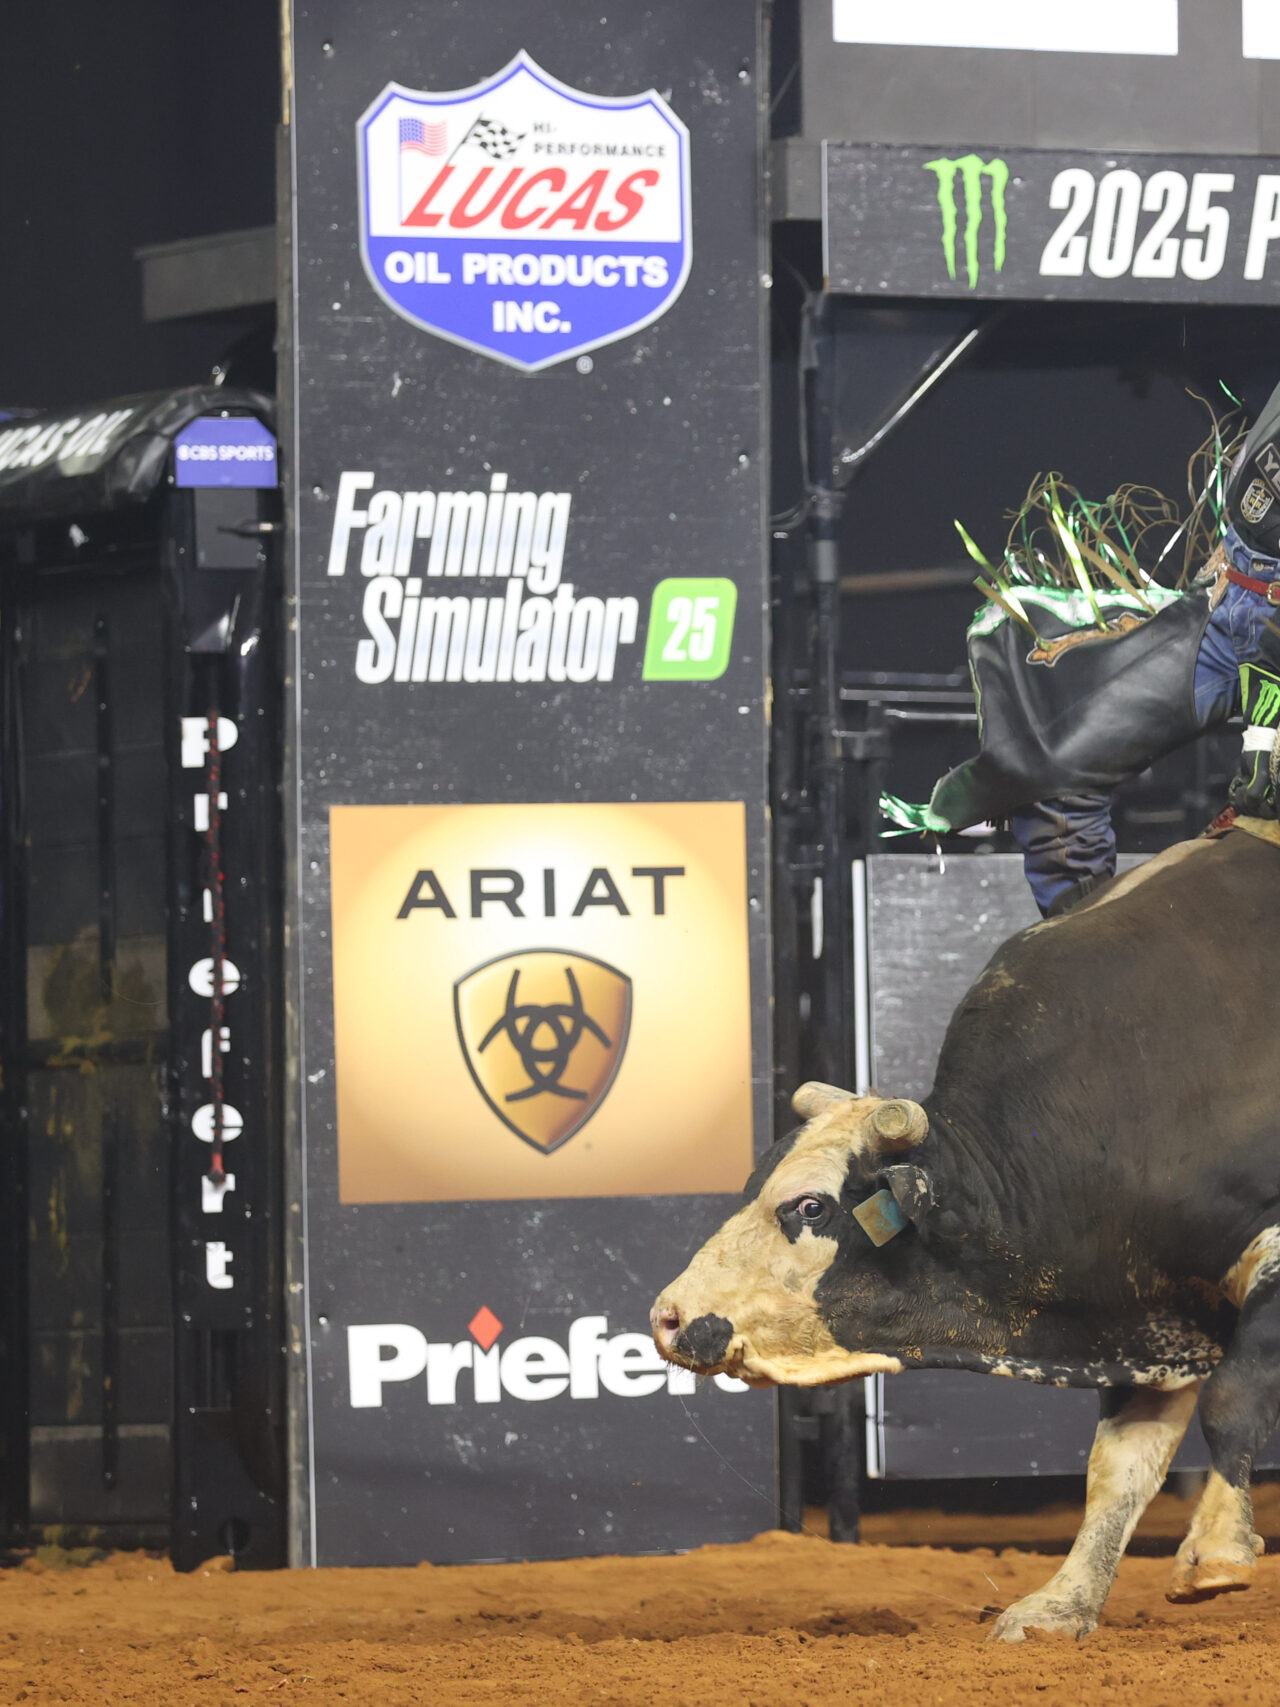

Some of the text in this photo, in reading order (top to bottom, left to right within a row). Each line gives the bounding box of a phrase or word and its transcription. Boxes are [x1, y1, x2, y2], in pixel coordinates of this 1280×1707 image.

[533, 142, 666, 157] PERFORMANCE
[400, 165, 661, 232] LUCAS
[1039, 168, 1236, 280] 2025
[384, 252, 669, 288] OIL PRODUCTS
[492, 301, 572, 334] INC.
[190, 444, 275, 462] CBS SPORTS
[327, 472, 572, 593] Farming
[355, 577, 721, 684] Simulator 25
[396, 866, 686, 919] ARIAT
